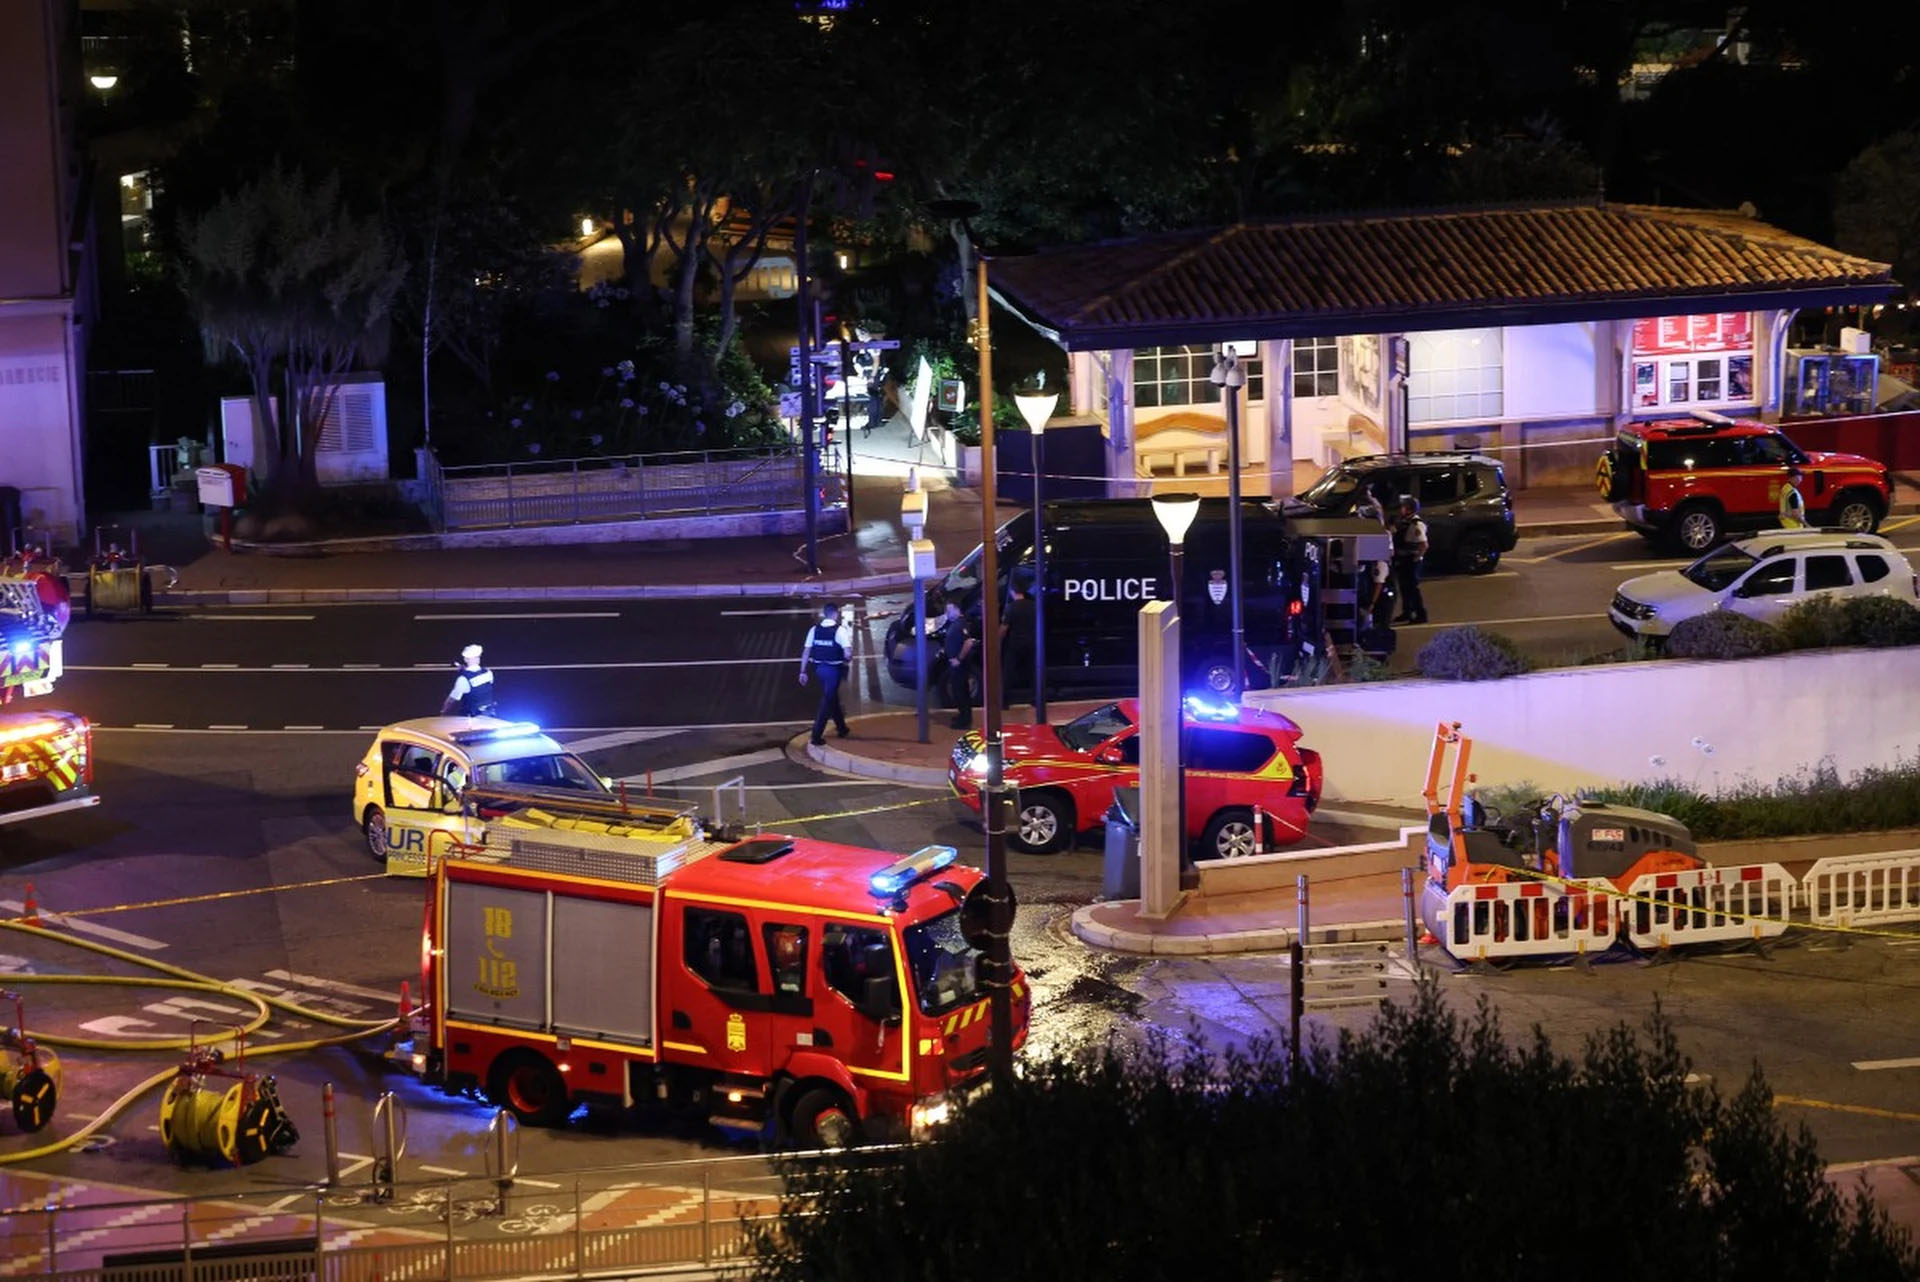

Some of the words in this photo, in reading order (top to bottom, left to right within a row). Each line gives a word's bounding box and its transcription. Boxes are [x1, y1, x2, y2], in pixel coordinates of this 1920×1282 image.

[1064, 577, 1157, 601] POLICE
[482, 907, 513, 938] 18
[478, 956, 517, 988] 112
